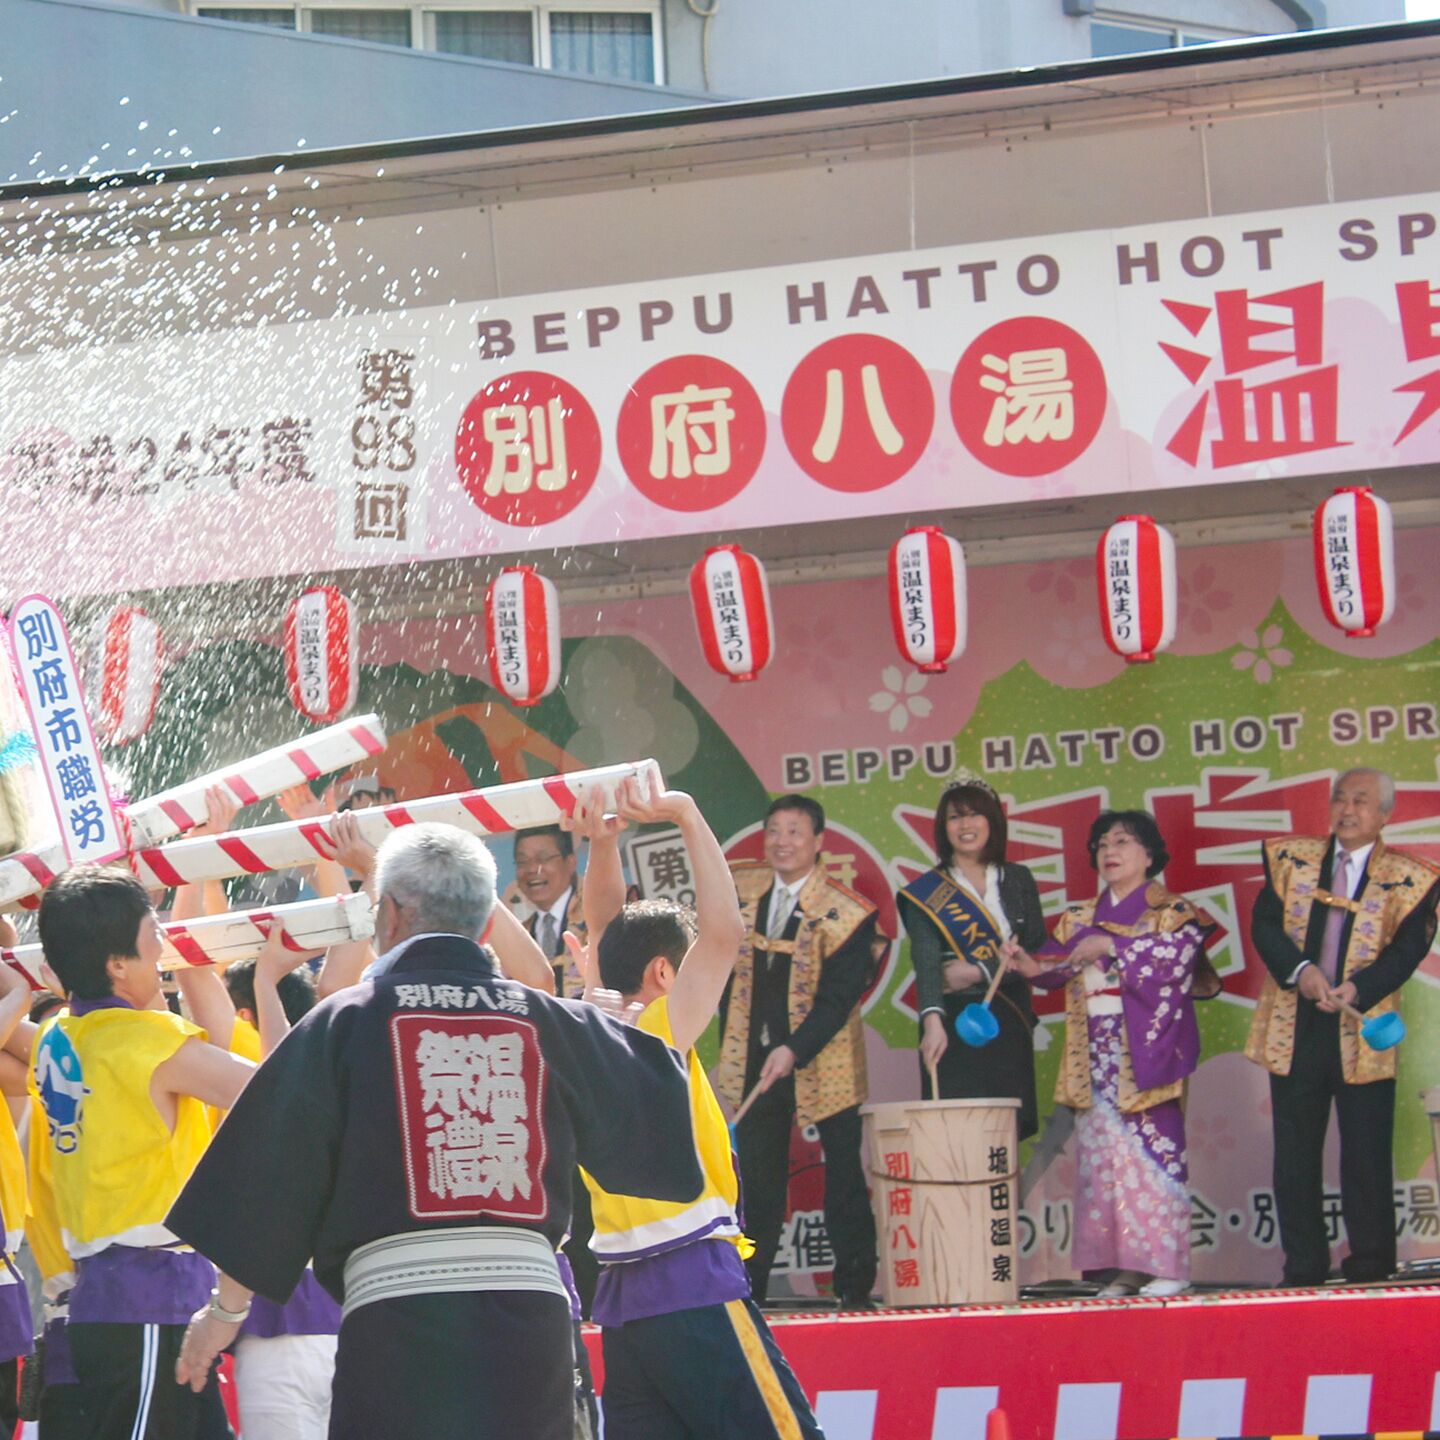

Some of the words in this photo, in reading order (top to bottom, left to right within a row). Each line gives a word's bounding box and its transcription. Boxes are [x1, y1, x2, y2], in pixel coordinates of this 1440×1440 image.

[480, 293, 735, 359] BEPPU
[786, 254, 1061, 324] HATTO
[1116, 228, 1284, 285] HOT
[1339, 213, 1436, 262] SP
[481, 346, 1074, 498] 別府八湯
[1157, 280, 1440, 470] 温
[902, 571, 926, 648] 温泉まつり
[1109, 559, 1131, 640] 温泉まつり
[1327, 536, 1354, 616] 温泉まつり
[715, 590, 744, 664] 温泉まつり
[17, 608, 107, 850] 別府市職労
[785, 744, 953, 786] BEPPU
[985, 726, 1162, 769] HATTO
[1193, 716, 1302, 754] HOT
[1331, 705, 1440, 744] SPR
[394, 984, 529, 1016] 別府八湯
[884, 1152, 921, 1288] 別府八湯
